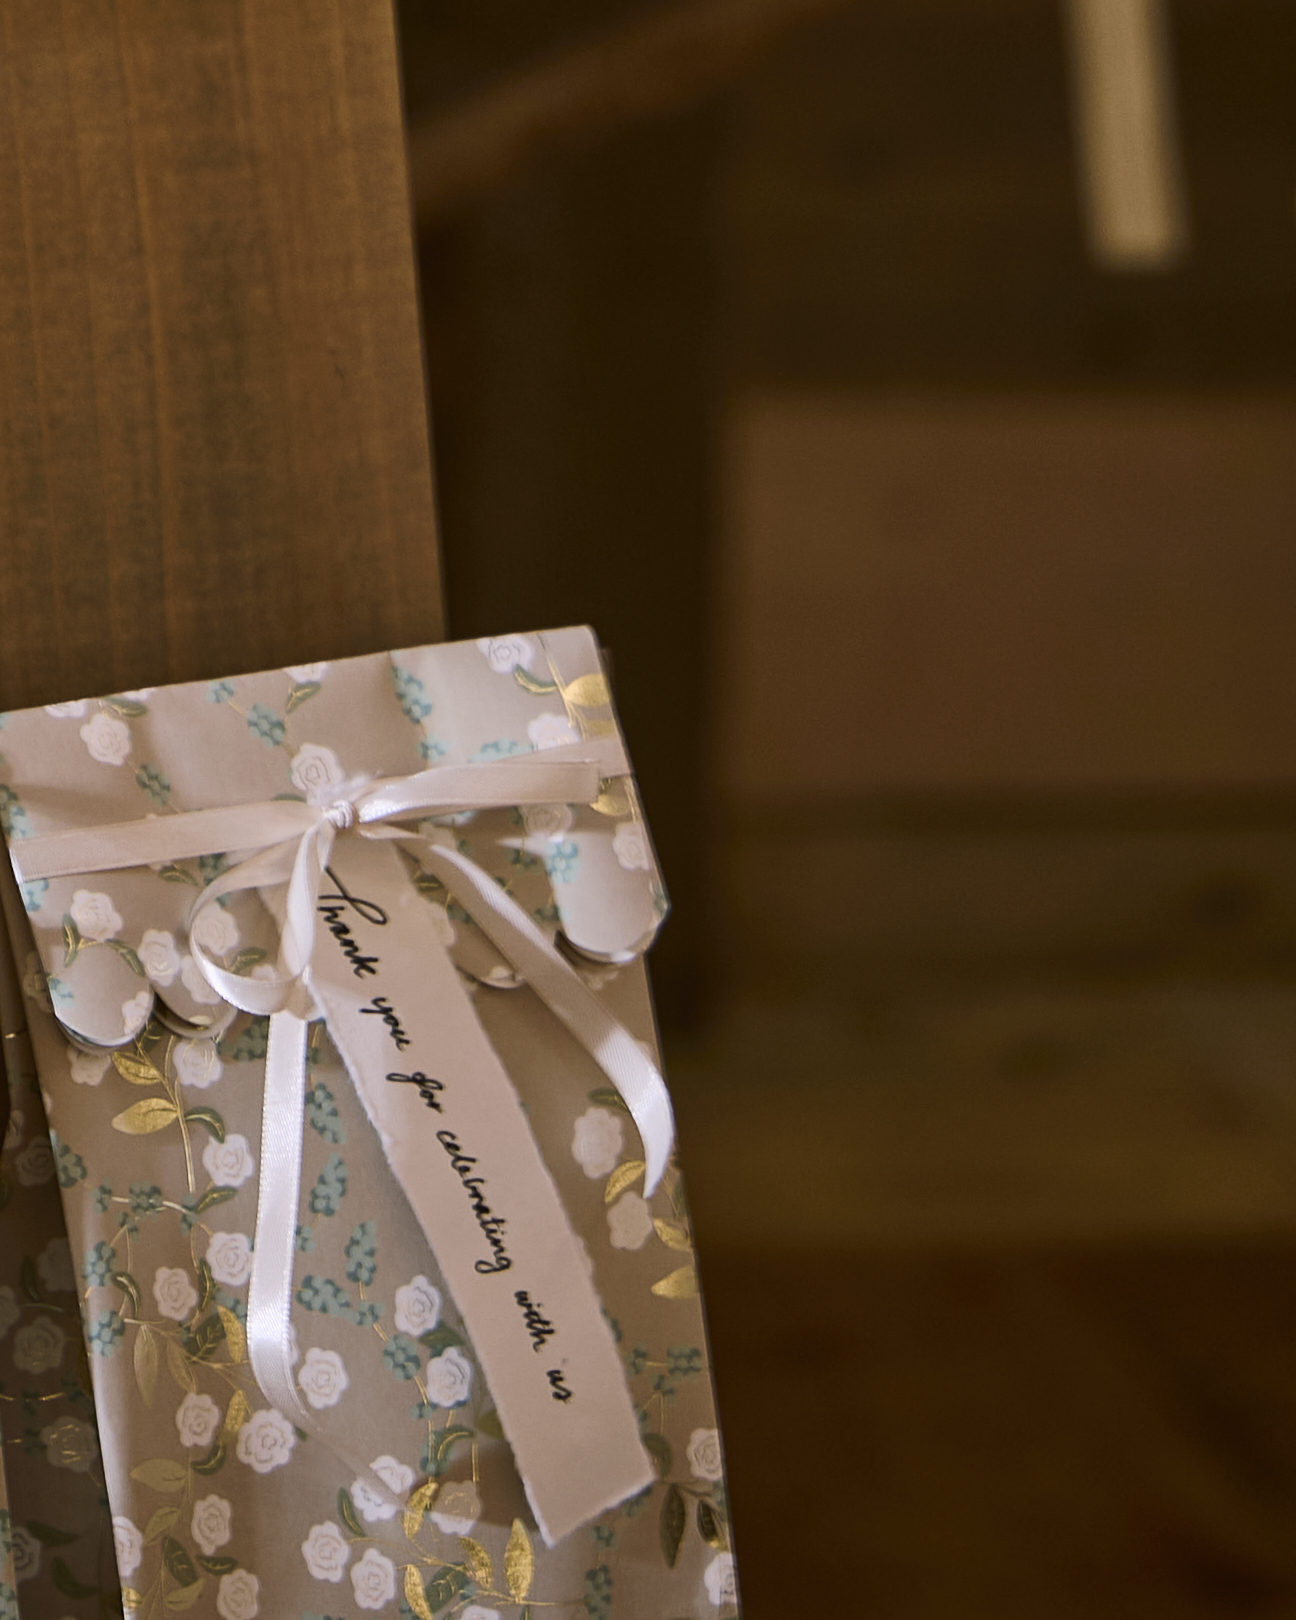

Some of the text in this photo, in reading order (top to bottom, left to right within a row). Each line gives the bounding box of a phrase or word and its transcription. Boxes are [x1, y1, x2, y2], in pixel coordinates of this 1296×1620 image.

[317, 866, 572, 1403] Thank you for celebrating with us
